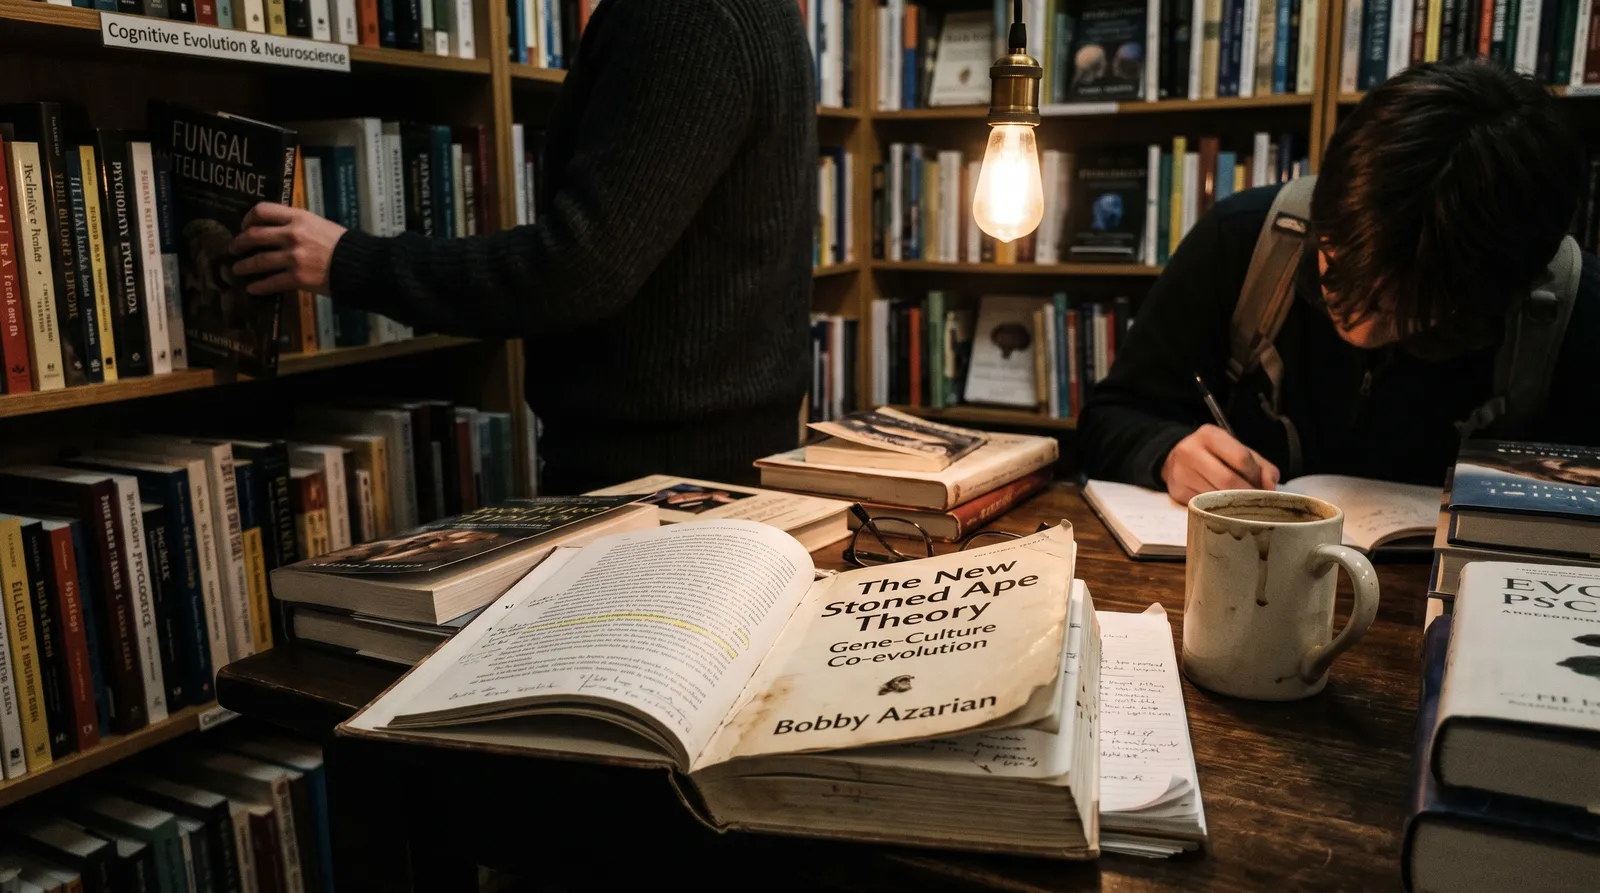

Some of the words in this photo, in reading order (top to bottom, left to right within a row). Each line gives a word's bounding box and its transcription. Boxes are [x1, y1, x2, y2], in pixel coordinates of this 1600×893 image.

[108, 21, 179, 46] Cognitive
[183, 32, 247, 53] Evolution
[250, 40, 262, 55] &
[265, 42, 346, 66] Neuroscience
[172, 120, 253, 167] FUNGAL
[820, 586, 953, 618] Stoned
[960, 572, 1039, 599] Ape
[858, 576, 921, 597] The
[934, 559, 1018, 585] New
[855, 601, 991, 632] Theory
[827, 637, 987, 668] Co-evolution
[829, 623, 997, 654] Gene-Culture
[773, 713, 870, 736] Bobby
[877, 693, 998, 723] Azarian
